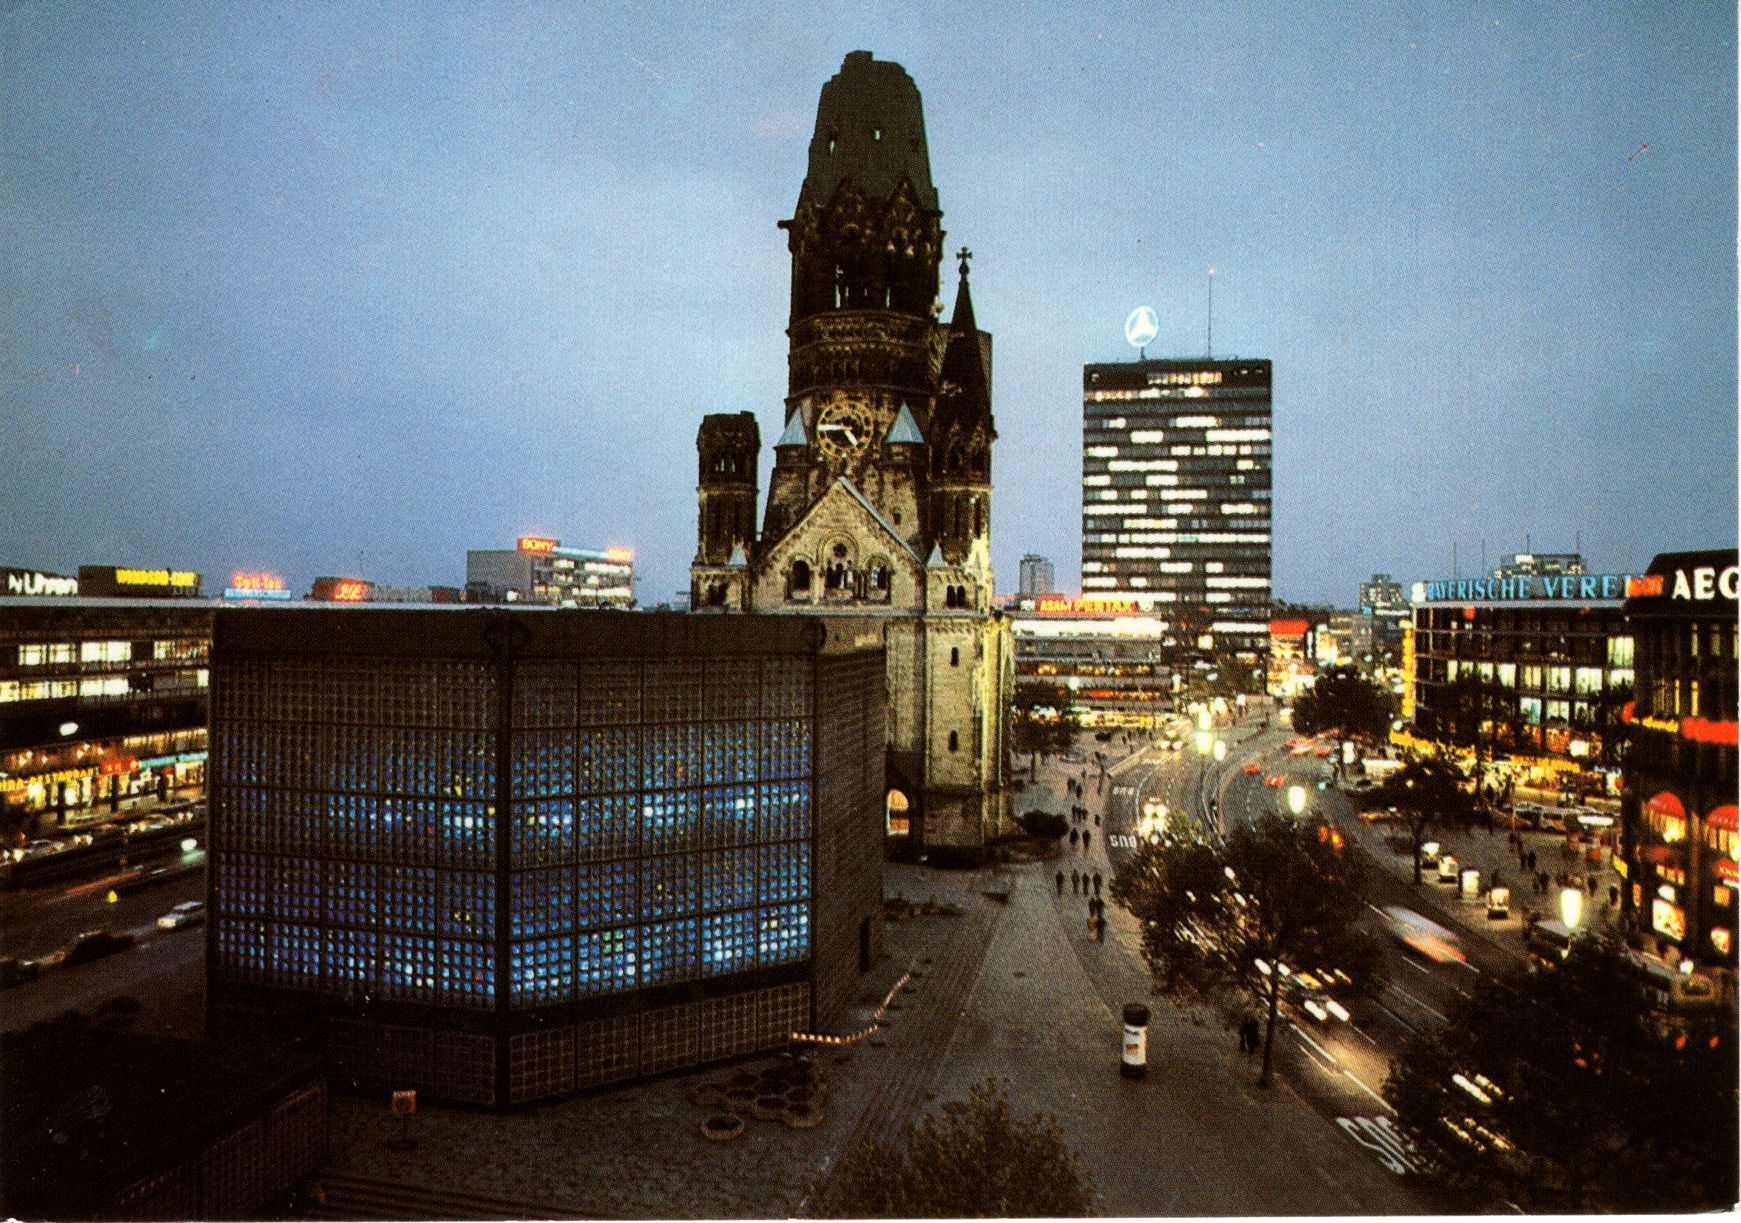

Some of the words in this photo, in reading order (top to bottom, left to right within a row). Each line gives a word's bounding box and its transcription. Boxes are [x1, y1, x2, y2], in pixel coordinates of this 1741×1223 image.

[521, 538, 551, 551] SONY
[1427, 579, 1532, 600] BAYERISCHE
[1671, 566, 1739, 600] AEG
[1075, 599, 1132, 613] PENTAX
